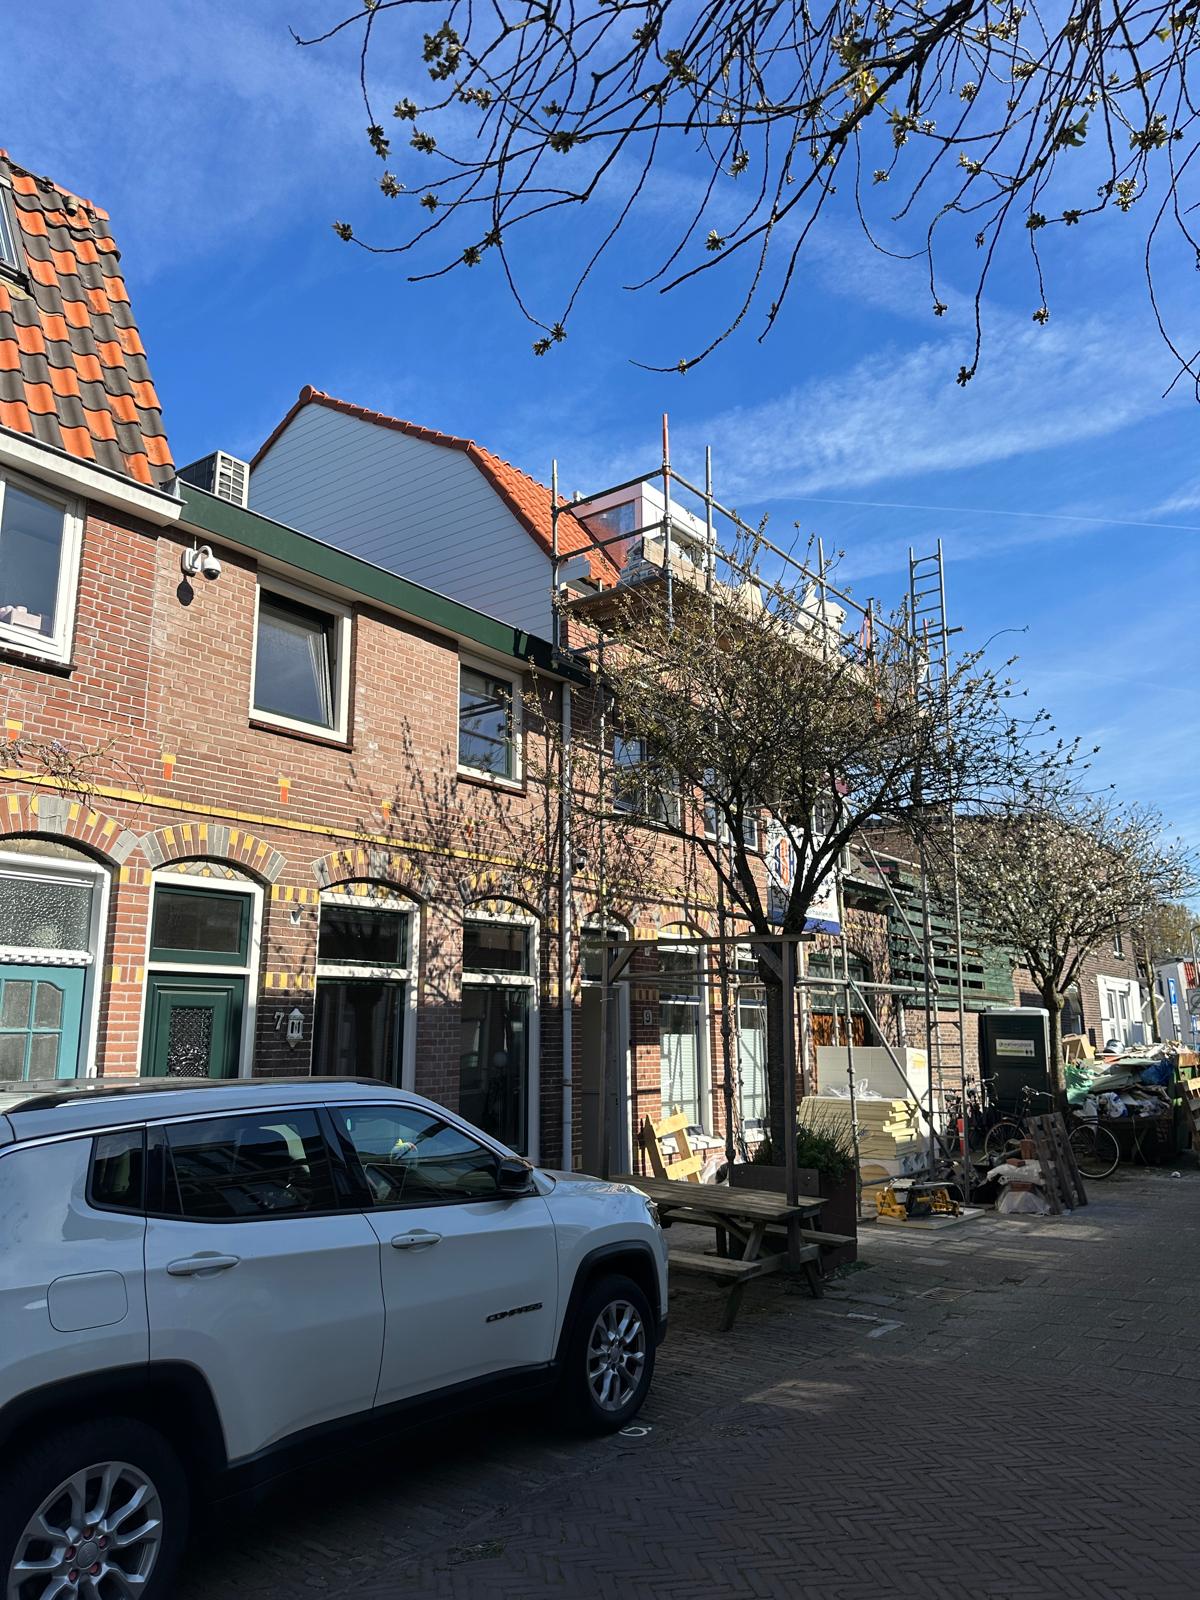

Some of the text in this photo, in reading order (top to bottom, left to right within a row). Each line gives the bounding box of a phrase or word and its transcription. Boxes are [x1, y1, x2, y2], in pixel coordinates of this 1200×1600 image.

[274, 1011, 285, 1031] 7
[645, 1010, 652, 1023] 9
[486, 1301, 543, 1323] COMPASS
